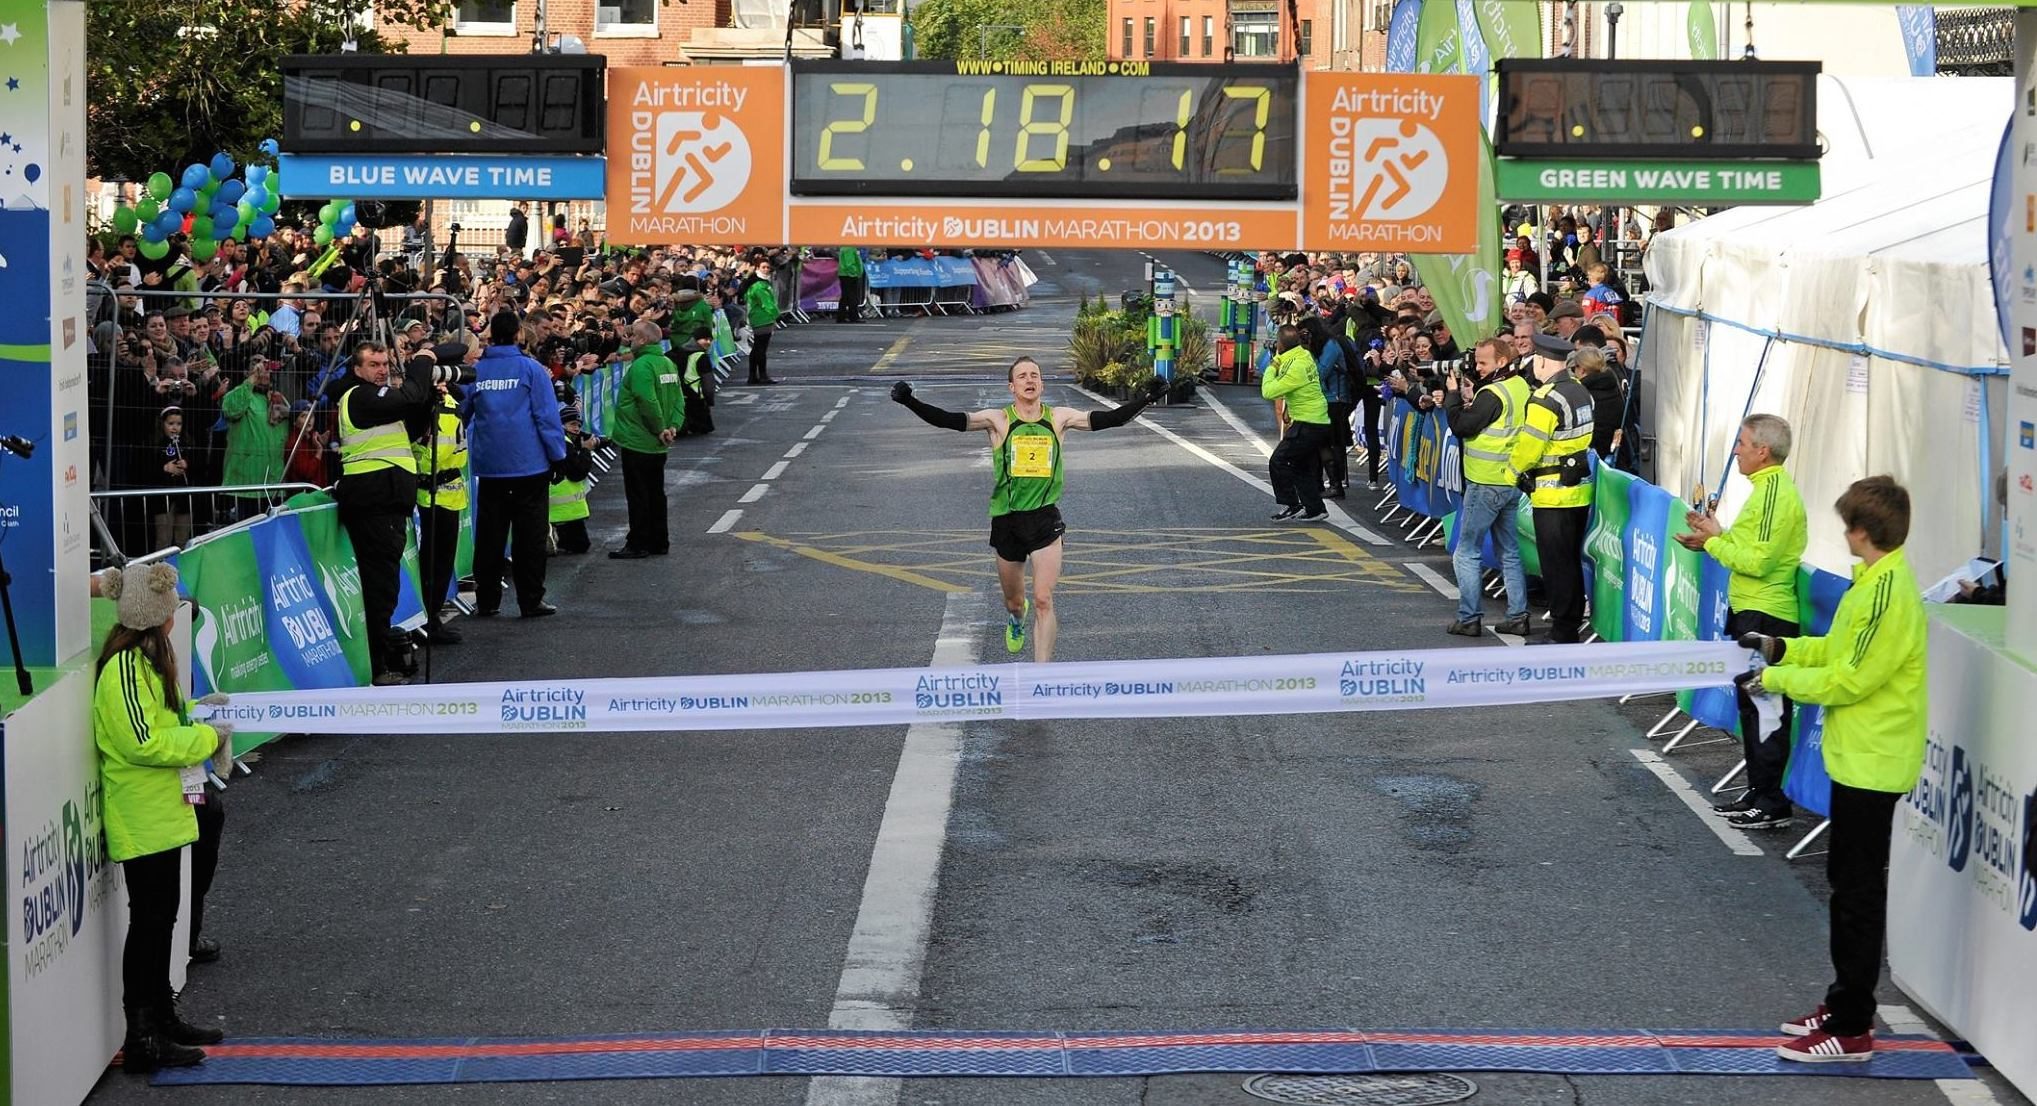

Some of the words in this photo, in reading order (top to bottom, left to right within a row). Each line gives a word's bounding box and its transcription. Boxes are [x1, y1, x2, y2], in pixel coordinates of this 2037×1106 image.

[632, 81, 747, 112] Airtricity
[1331, 86, 1445, 120] Airtricity
[630, 111, 652, 214] DUBLIN
[1329, 117, 1350, 220] DUBLIN
[330, 166, 396, 187] BLUE
[403, 167, 479, 187] WAVE
[488, 168, 552, 187] TIME
[1539, 169, 1627, 190] GREEN
[1634, 170, 1711, 190] WAVE
[1717, 171, 1781, 190] TIME
[630, 217, 746, 234] MARATHON
[841, 215, 937, 240] Airtricity
[943, 216, 1039, 238] DUBLIN
[1044, 220, 1180, 240] MARATHON
[1183, 221, 1241, 241] 2013
[1328, 223, 1443, 242] MARATHON
[476, 378, 518, 392] SECURITY
[1029, 452, 1036, 461] 2
[221, 595, 264, 648] Airtricity
[1340, 658, 1424, 678] Airtricity
[1446, 667, 1515, 685] Airtricity
[1518, 666, 1585, 681] DUBLIN
[1588, 662, 1683, 677] MARATHON
[1686, 661, 1726, 674] 2013
[915, 672, 999, 692] Airtricity
[1032, 681, 1101, 699] Airtricity
[1105, 682, 1173, 695] DUBLIN
[1176, 679, 1273, 693] MARATHON
[1276, 676, 1316, 690] 2013
[1340, 678, 1425, 696] DUBLIN
[501, 687, 584, 705] Airtricity
[608, 695, 676, 713] Airtricity
[681, 696, 749, 710] DUBLIN
[752, 693, 848, 708] MARATHON
[851, 691, 892, 704] 2013
[916, 692, 1002, 709] DUBLIN
[269, 704, 336, 719] DUBLIN
[339, 702, 434, 717] MARATHON
[436, 702, 478, 715] 2013
[501, 705, 586, 721] DUBLIN
[187, 794, 201, 804] VIP
[1976, 763, 2018, 838] Airtricity
[23, 818, 60, 889] Airtricity
[1975, 811, 2016, 881] DUBLIN
[24, 871, 66, 944] DUBLIN
[24, 919, 69, 983] MARATHON
